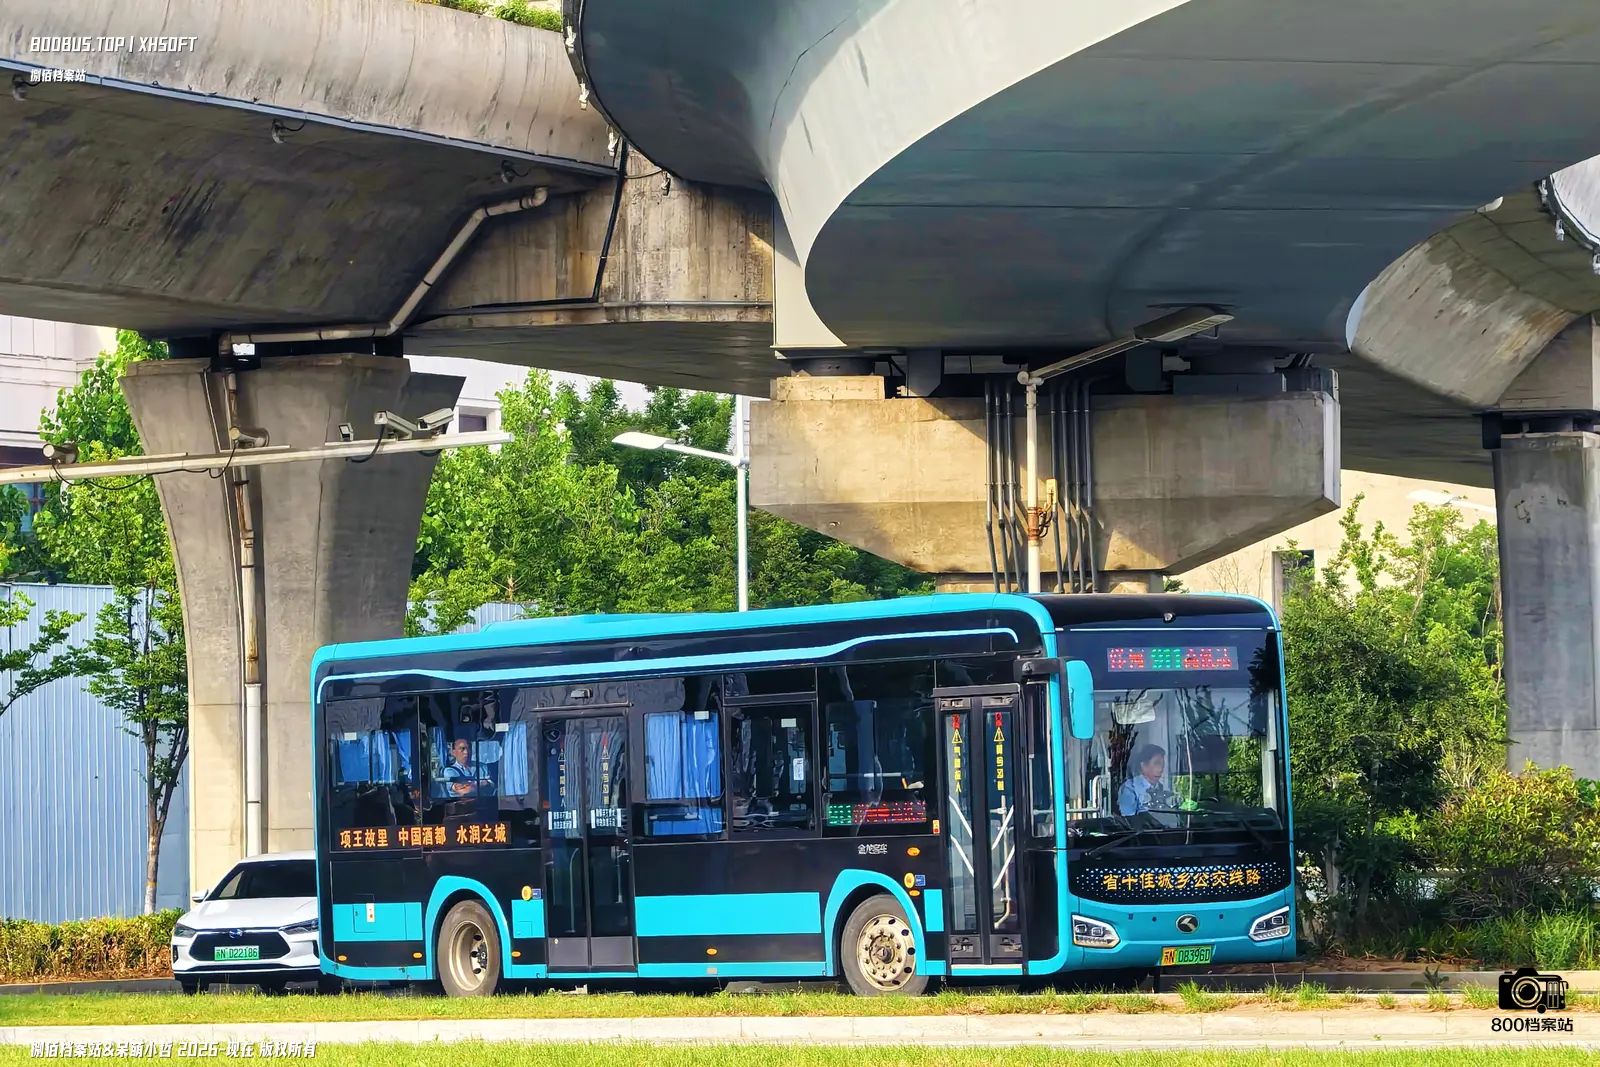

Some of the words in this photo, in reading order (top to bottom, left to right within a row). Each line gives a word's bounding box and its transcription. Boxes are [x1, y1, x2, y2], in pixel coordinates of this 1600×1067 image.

[340, 829, 389, 848] 项王故里
[398, 826, 447, 847] 中国酒都
[456, 823, 507, 844] 水润之城
[1103, 869, 1261, 890] 省十佳城乡公交线路
